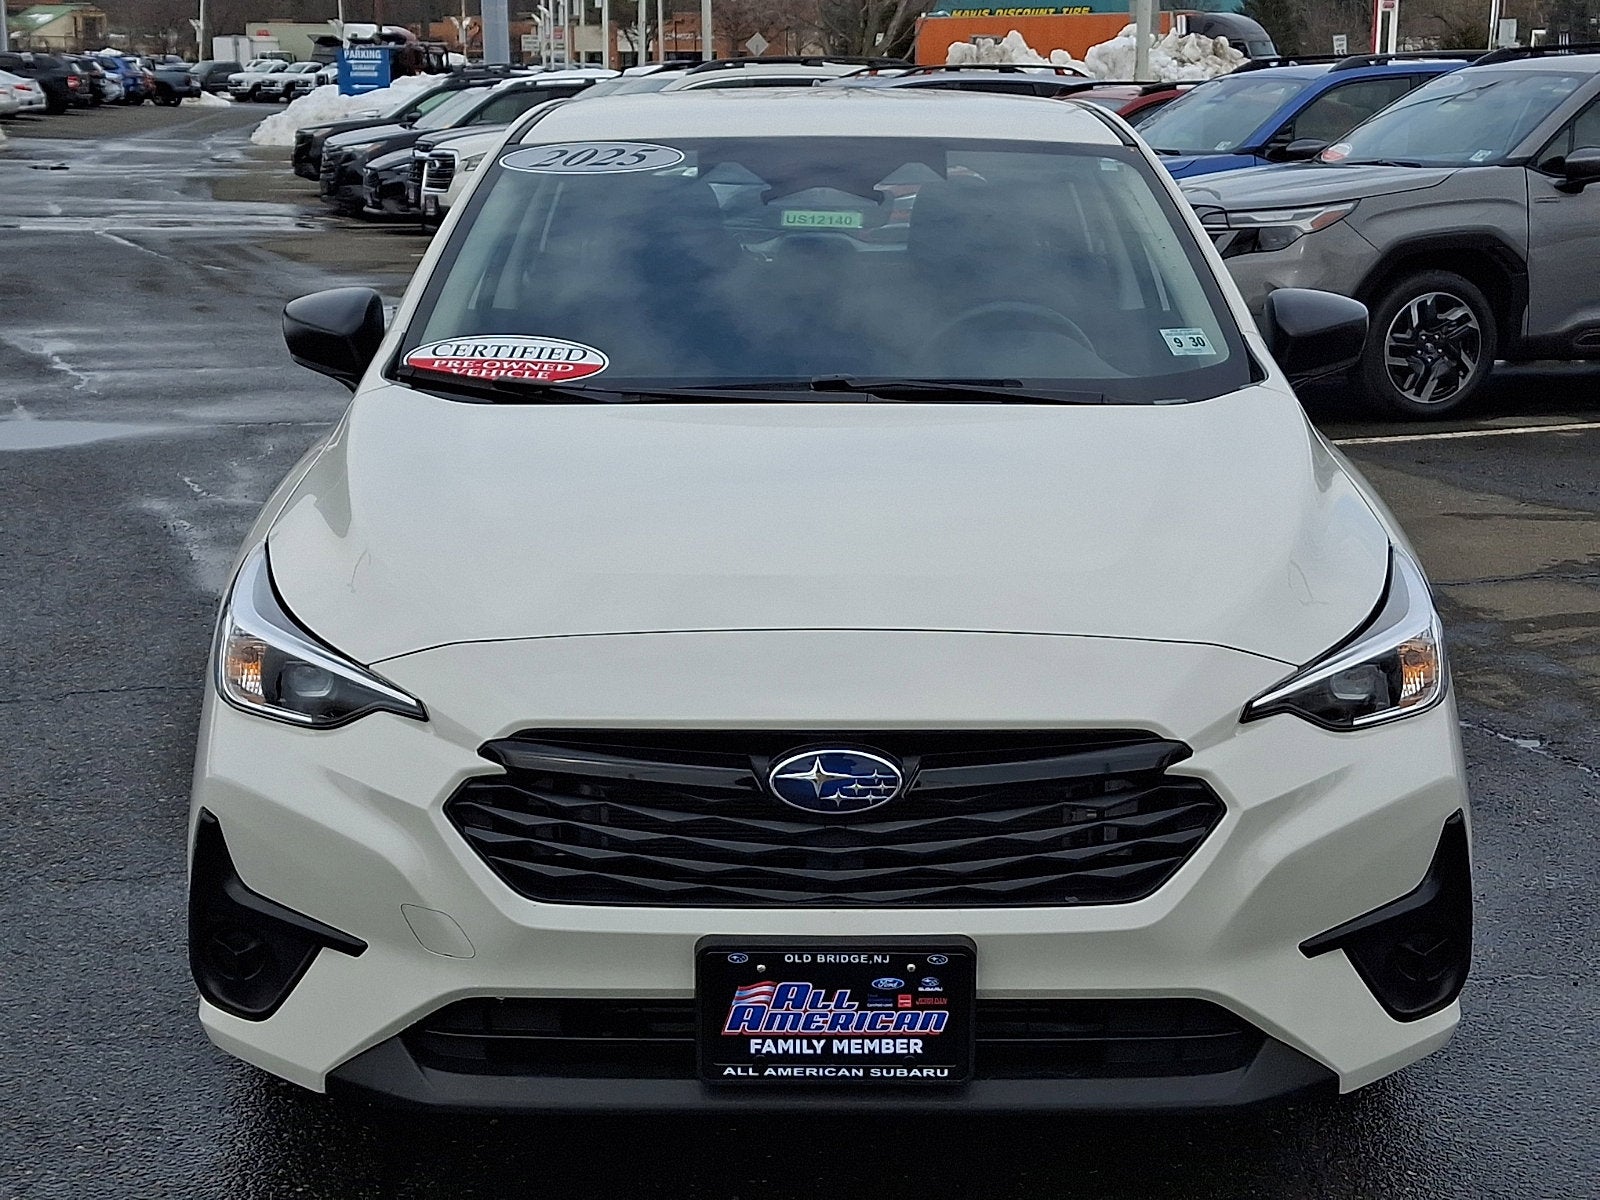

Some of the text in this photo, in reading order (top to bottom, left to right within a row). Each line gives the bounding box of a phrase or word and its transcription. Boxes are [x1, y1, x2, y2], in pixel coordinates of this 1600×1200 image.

[951, 6, 1092, 17] MAVIS DISCOUNT TIRE
[343, 49, 382, 59] PARKING
[528, 148, 659, 168] 2025
[785, 214, 853, 226] US12140
[1173, 336, 1206, 348] 9 30
[431, 343, 588, 362] CERTIFIED
[431, 359, 575, 373] PRE-OWNED
[451, 368, 550, 379] VEHICLE
[784, 954, 812, 964] OLD
[749, 1039, 923, 1054] FAMILY MEMBER
[722, 1066, 949, 1078] ALL AMERICAN SUBARU
